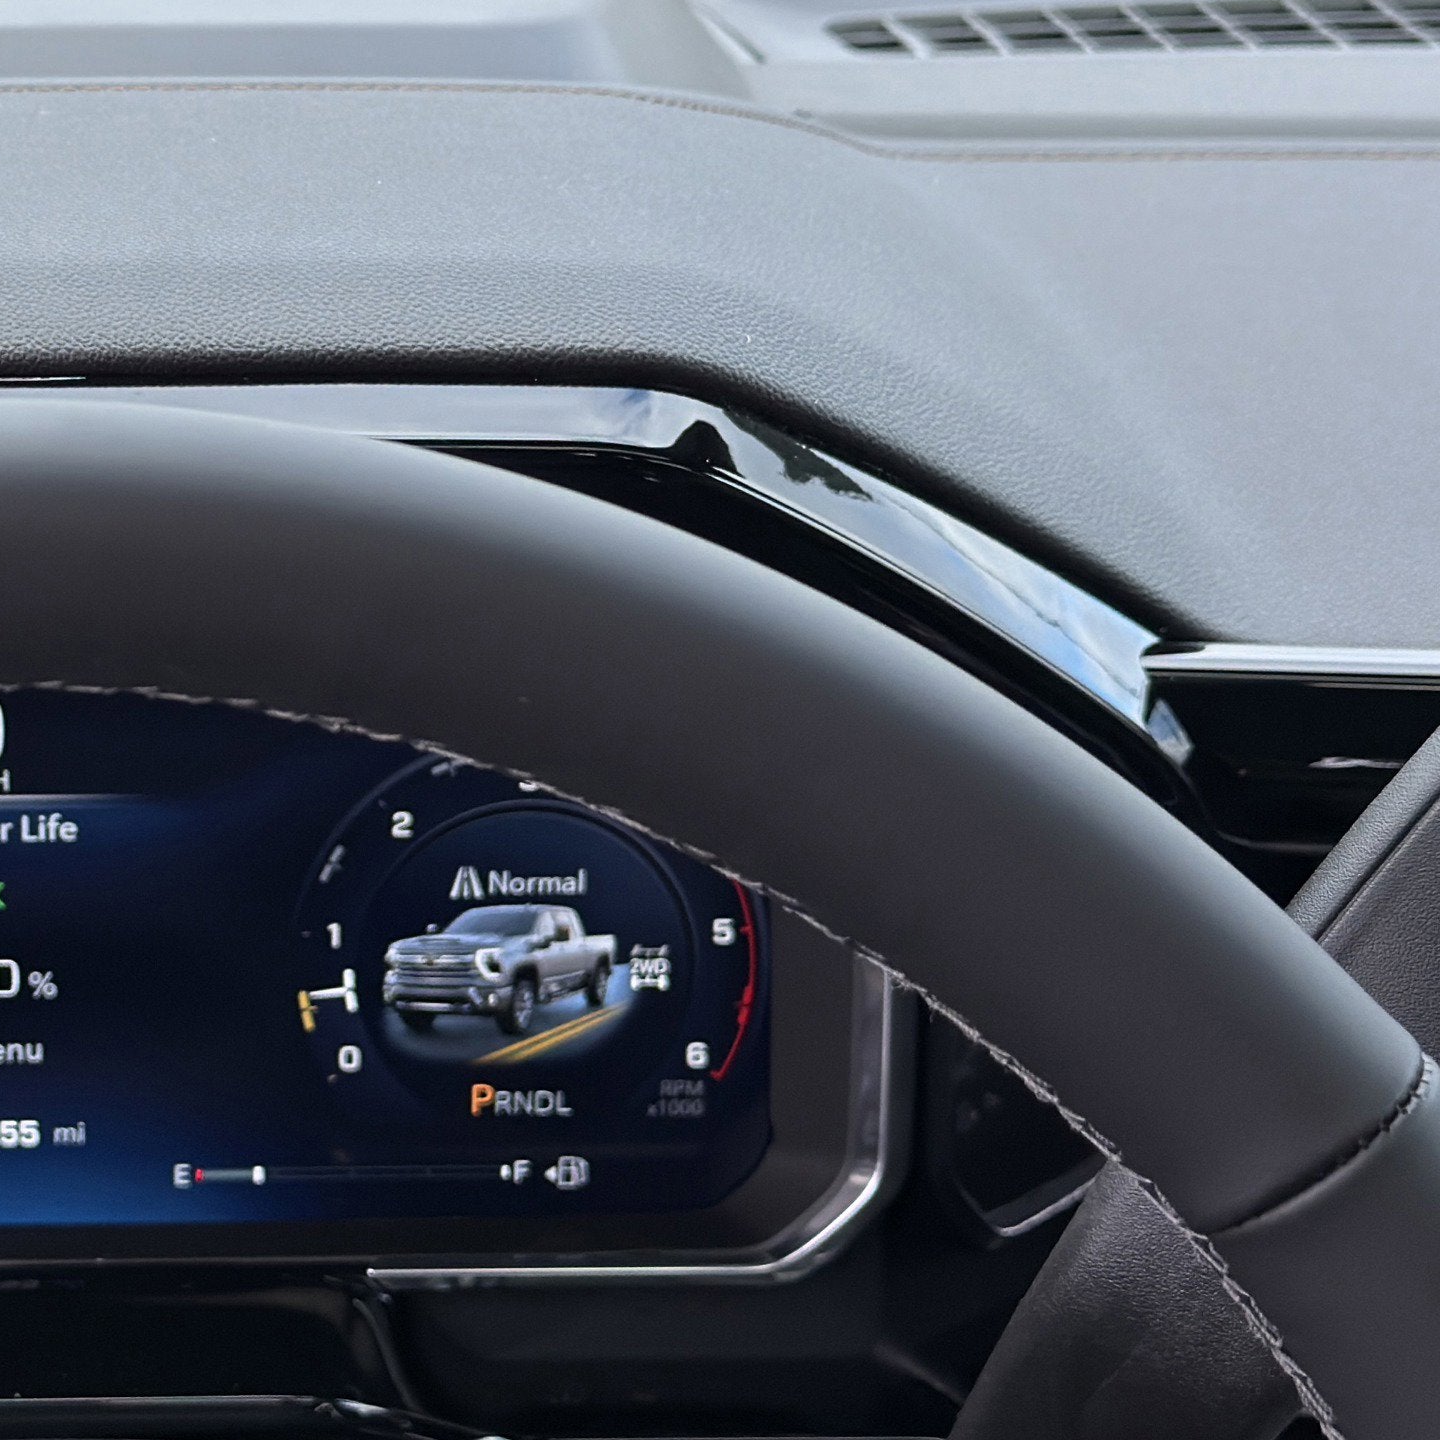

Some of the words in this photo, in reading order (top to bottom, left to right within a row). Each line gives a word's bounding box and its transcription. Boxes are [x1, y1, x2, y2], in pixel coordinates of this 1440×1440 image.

[20, 812, 79, 843] Life
[391, 811, 413, 838] 2
[488, 868, 586, 896] Normal
[326, 922, 341, 949] 1
[711, 917, 735, 946] 5
[27, 970, 59, 1000] %
[338, 1045, 362, 1073] 0
[685, 1041, 709, 1070] 6
[53, 1121, 87, 1146] mi
[173, 1163, 191, 1188] E
[513, 1159, 531, 1183] F
